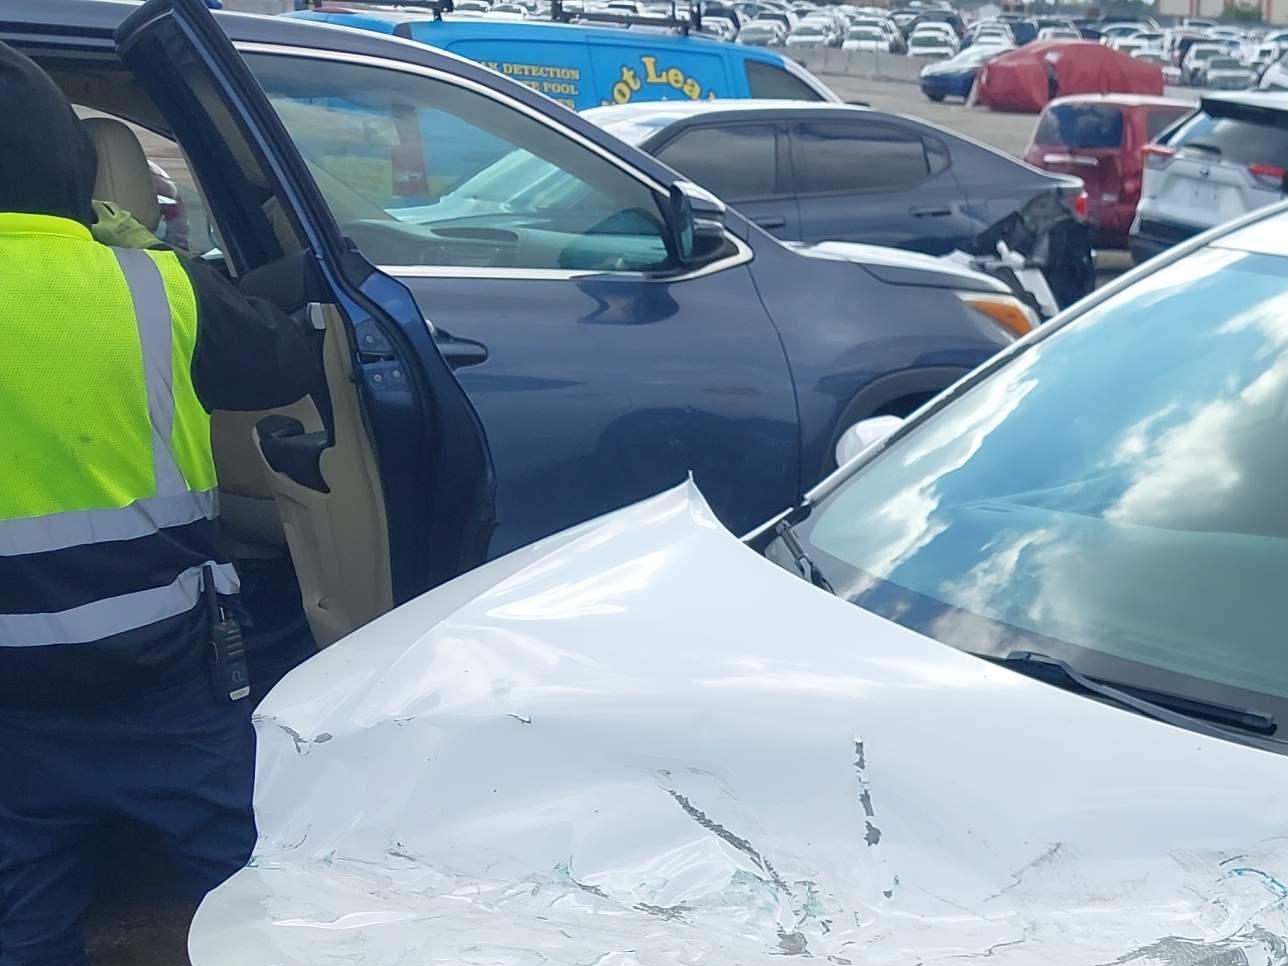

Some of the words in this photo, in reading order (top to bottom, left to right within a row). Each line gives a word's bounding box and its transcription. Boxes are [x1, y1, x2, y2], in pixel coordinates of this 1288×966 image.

[503, 63, 580, 80] DETECTION
[543, 82, 579, 95] POOL
[601, 66, 641, 104] ot
